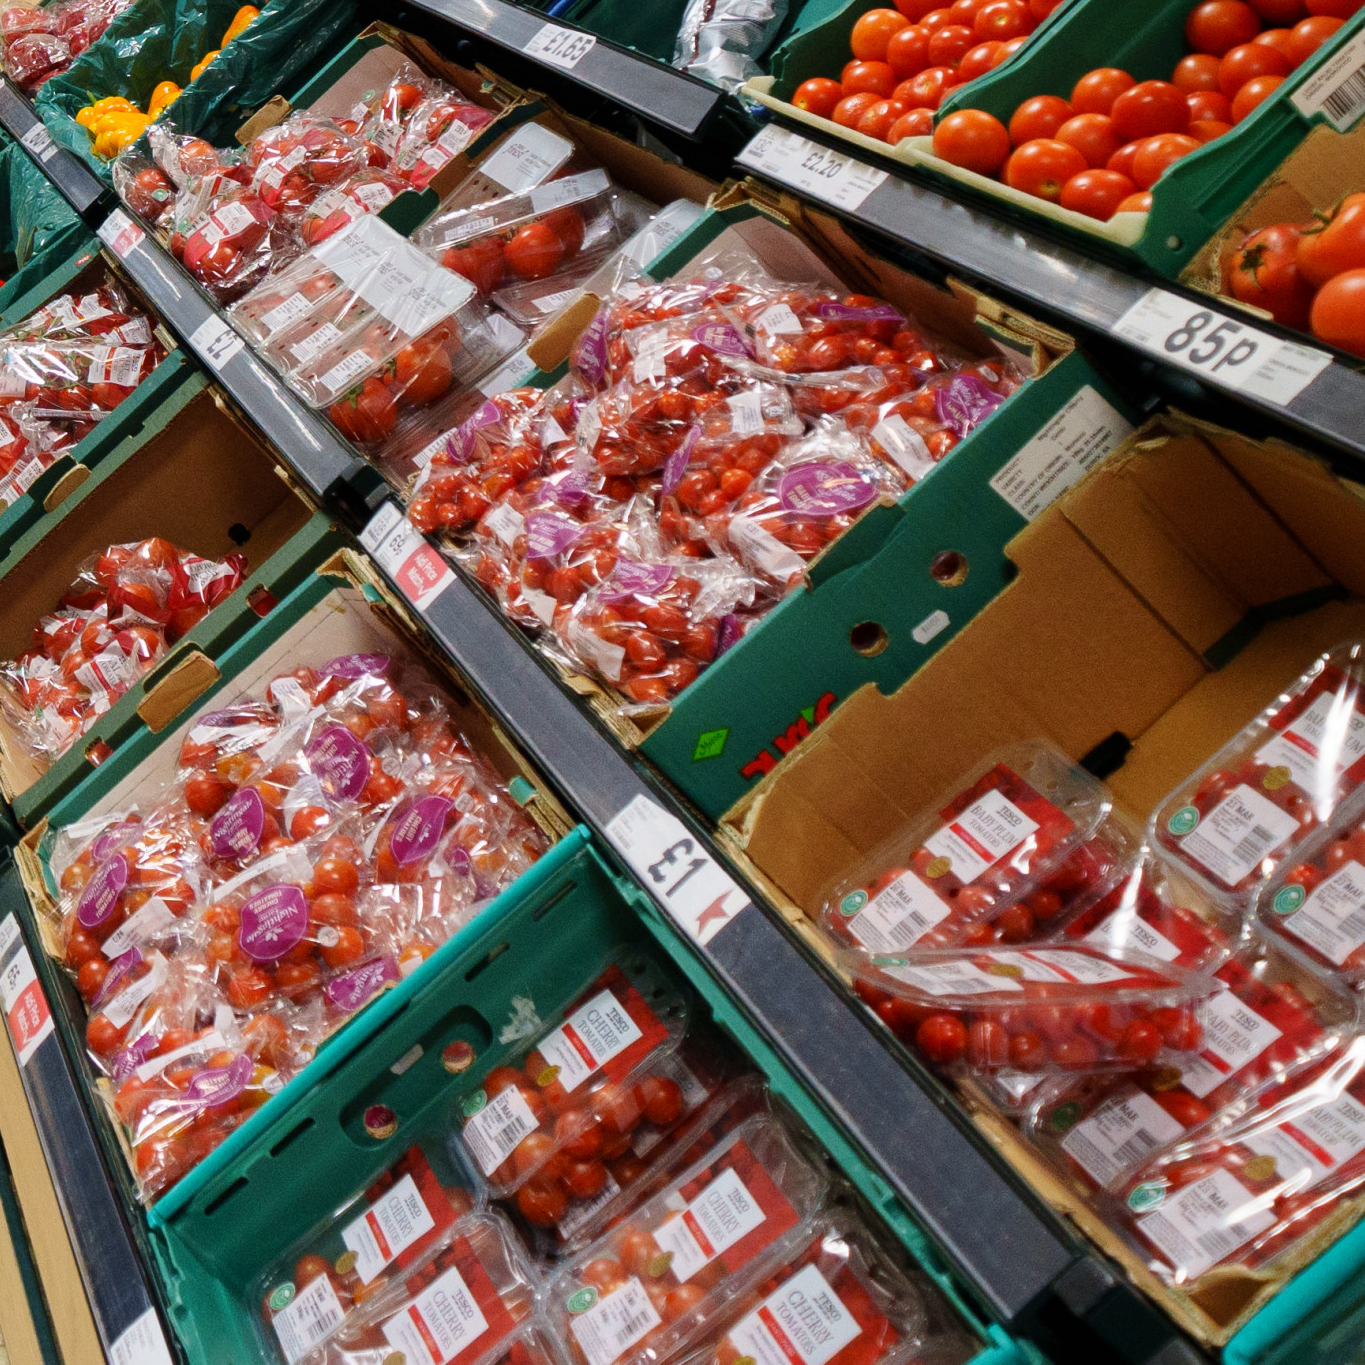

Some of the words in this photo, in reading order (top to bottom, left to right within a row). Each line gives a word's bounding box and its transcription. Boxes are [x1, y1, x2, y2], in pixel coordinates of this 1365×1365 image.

[542, 31, 592, 61] £1.65
[801, 152, 843, 179] £2.20
[1164, 311, 1259, 372] 85p
[969, 819, 1000, 849] TOMATOES
[970, 804, 996, 829] BABY
[993, 823, 1018, 846] PLUM
[1001, 805, 1022, 825] TESCO
[648, 838, 709, 899] £1
[246, 905, 299, 944] Nightingale
[1133, 925, 1159, 947] TESCO
[577, 1019, 607, 1057] TOMATOES
[586, 1009, 621, 1050] CHERRY
[610, 1007, 630, 1033] TESCO
[1234, 1009, 1260, 1031] TESCO
[388, 1196, 415, 1237] CHERRY
[408, 1193, 422, 1218] TESCO
[707, 1190, 742, 1236] CHERRY
[731, 1187, 750, 1213] TESCO
[378, 1208, 402, 1247] TOMATOES
[696, 1204, 725, 1243] TOMATOES
[434, 1290, 466, 1342] CHERRY
[455, 1288, 474, 1319] TESCO
[787, 1289, 834, 1346] CHERRY
[816, 1292, 842, 1322] TESCO
[423, 1302, 452, 1351] TOMATOES
[775, 1301, 816, 1356] TOMATOES
